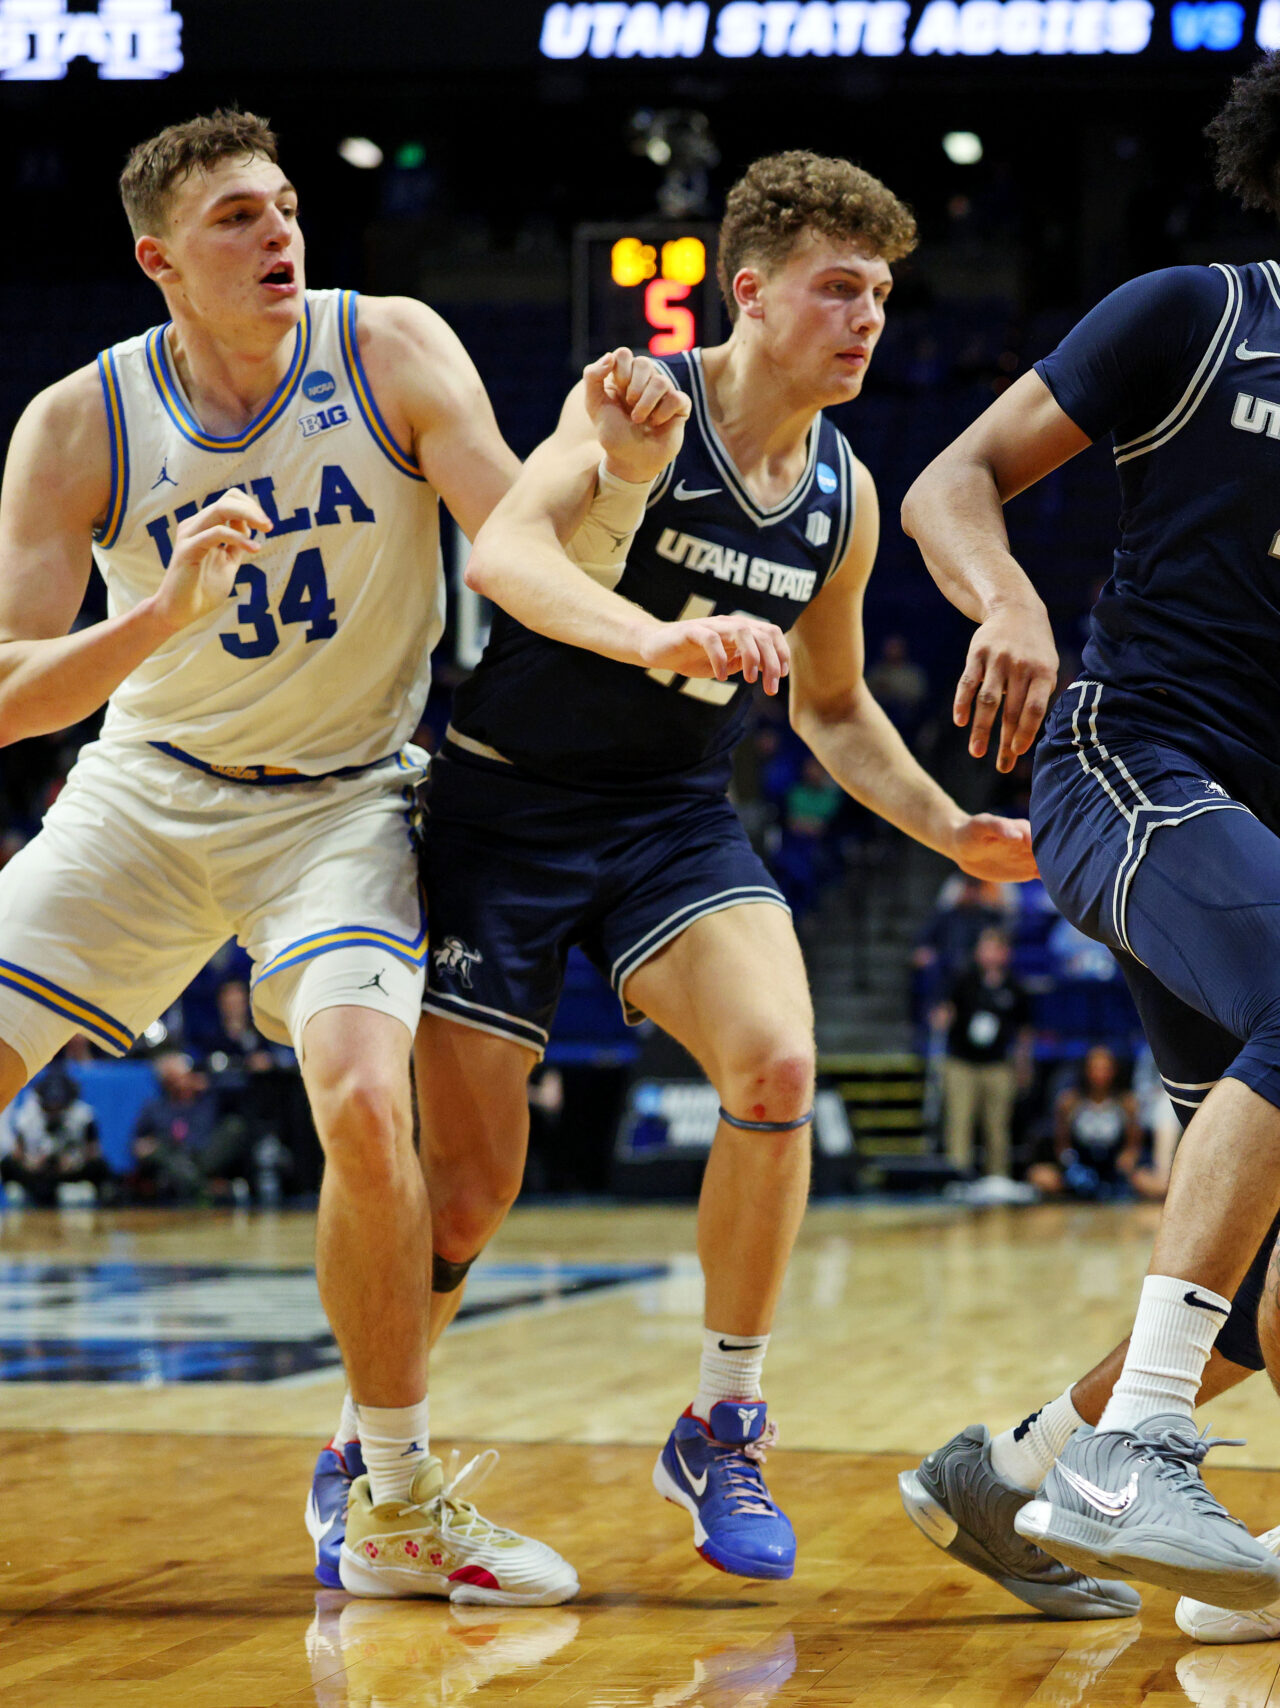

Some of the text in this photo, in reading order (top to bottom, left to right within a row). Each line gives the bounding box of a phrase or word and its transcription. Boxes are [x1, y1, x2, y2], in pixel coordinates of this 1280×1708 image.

[539, 2, 709, 60] UTAH
[713, 1, 910, 58] STATE
[909, 0, 1152, 56] AGGIES
[1170, 3, 1245, 52] VS
[644, 278, 695, 357] 5
[219, 547, 339, 660] 34
[655, 527, 818, 603] UTAH STATE
